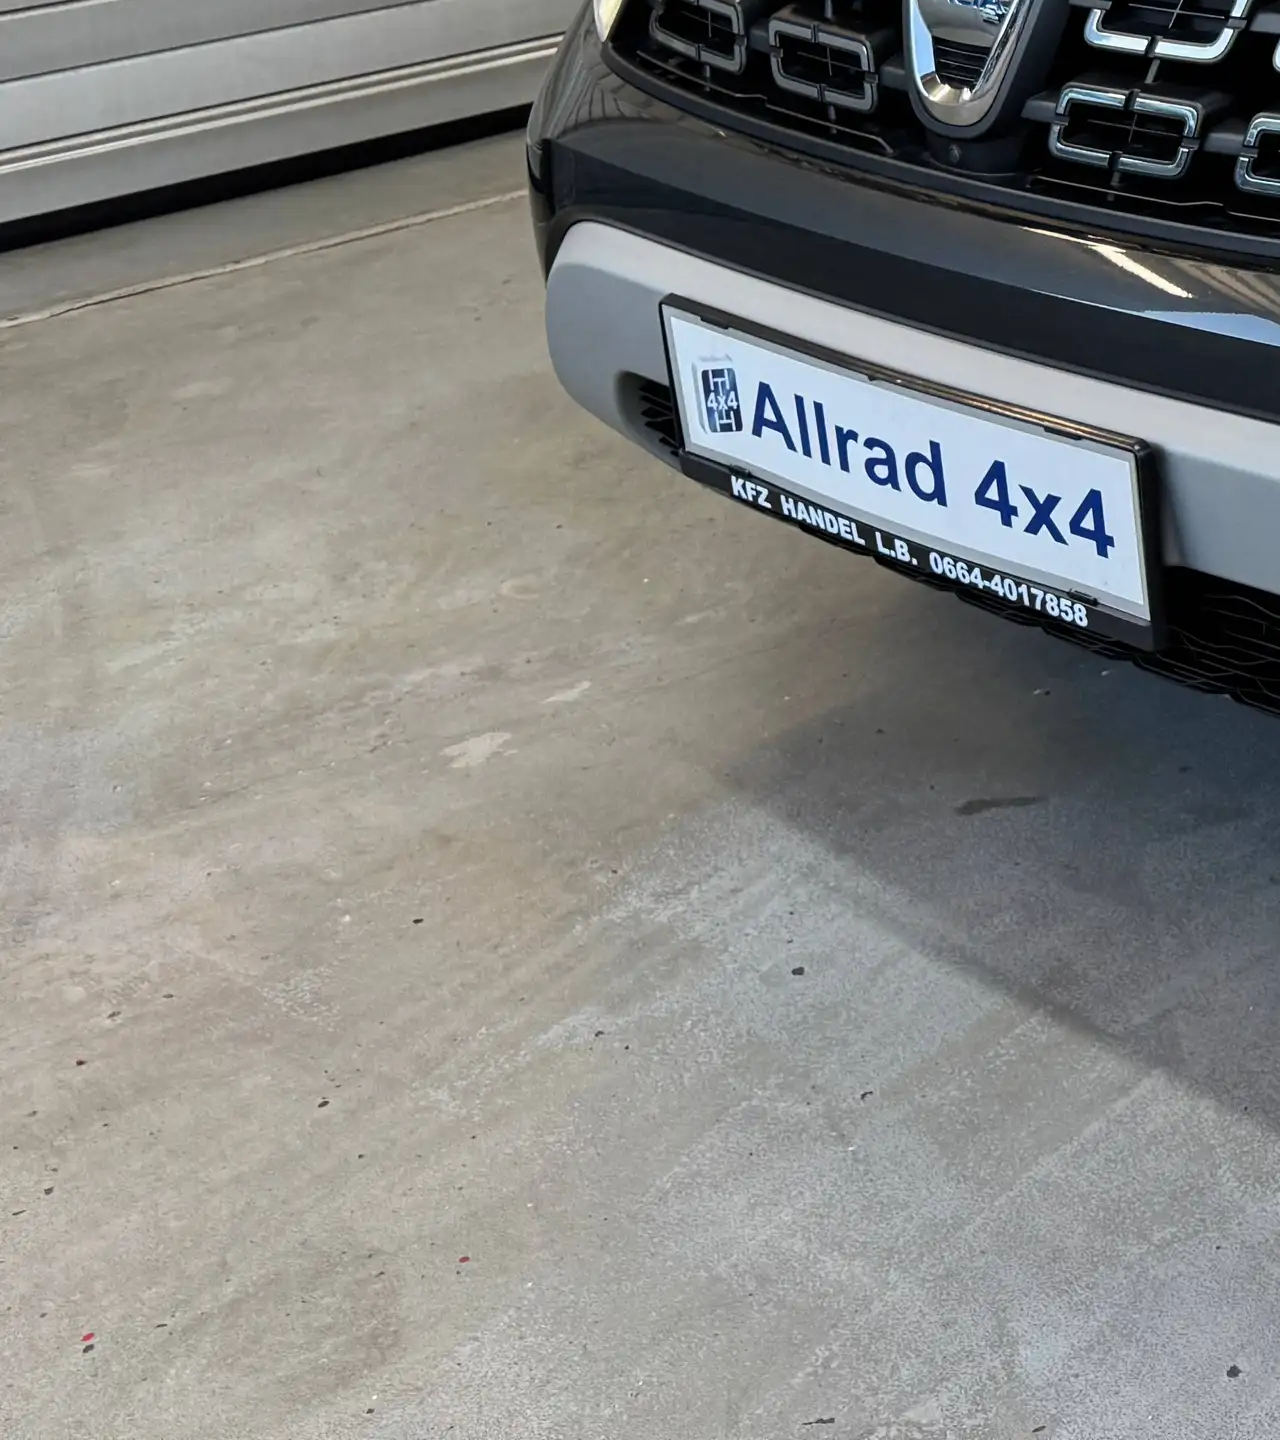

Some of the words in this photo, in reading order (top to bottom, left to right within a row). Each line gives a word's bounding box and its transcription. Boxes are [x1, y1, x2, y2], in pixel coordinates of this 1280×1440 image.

[706, 390, 739, 411] 4x4
[751, 381, 948, 507] Allrad
[974, 458, 1116, 559] 4x4
[730, 475, 772, 510] KFZ
[780, 494, 866, 547] HANDEL
[875, 531, 919, 566] L.B.
[929, 551, 1090, 628] 0664-4017858
